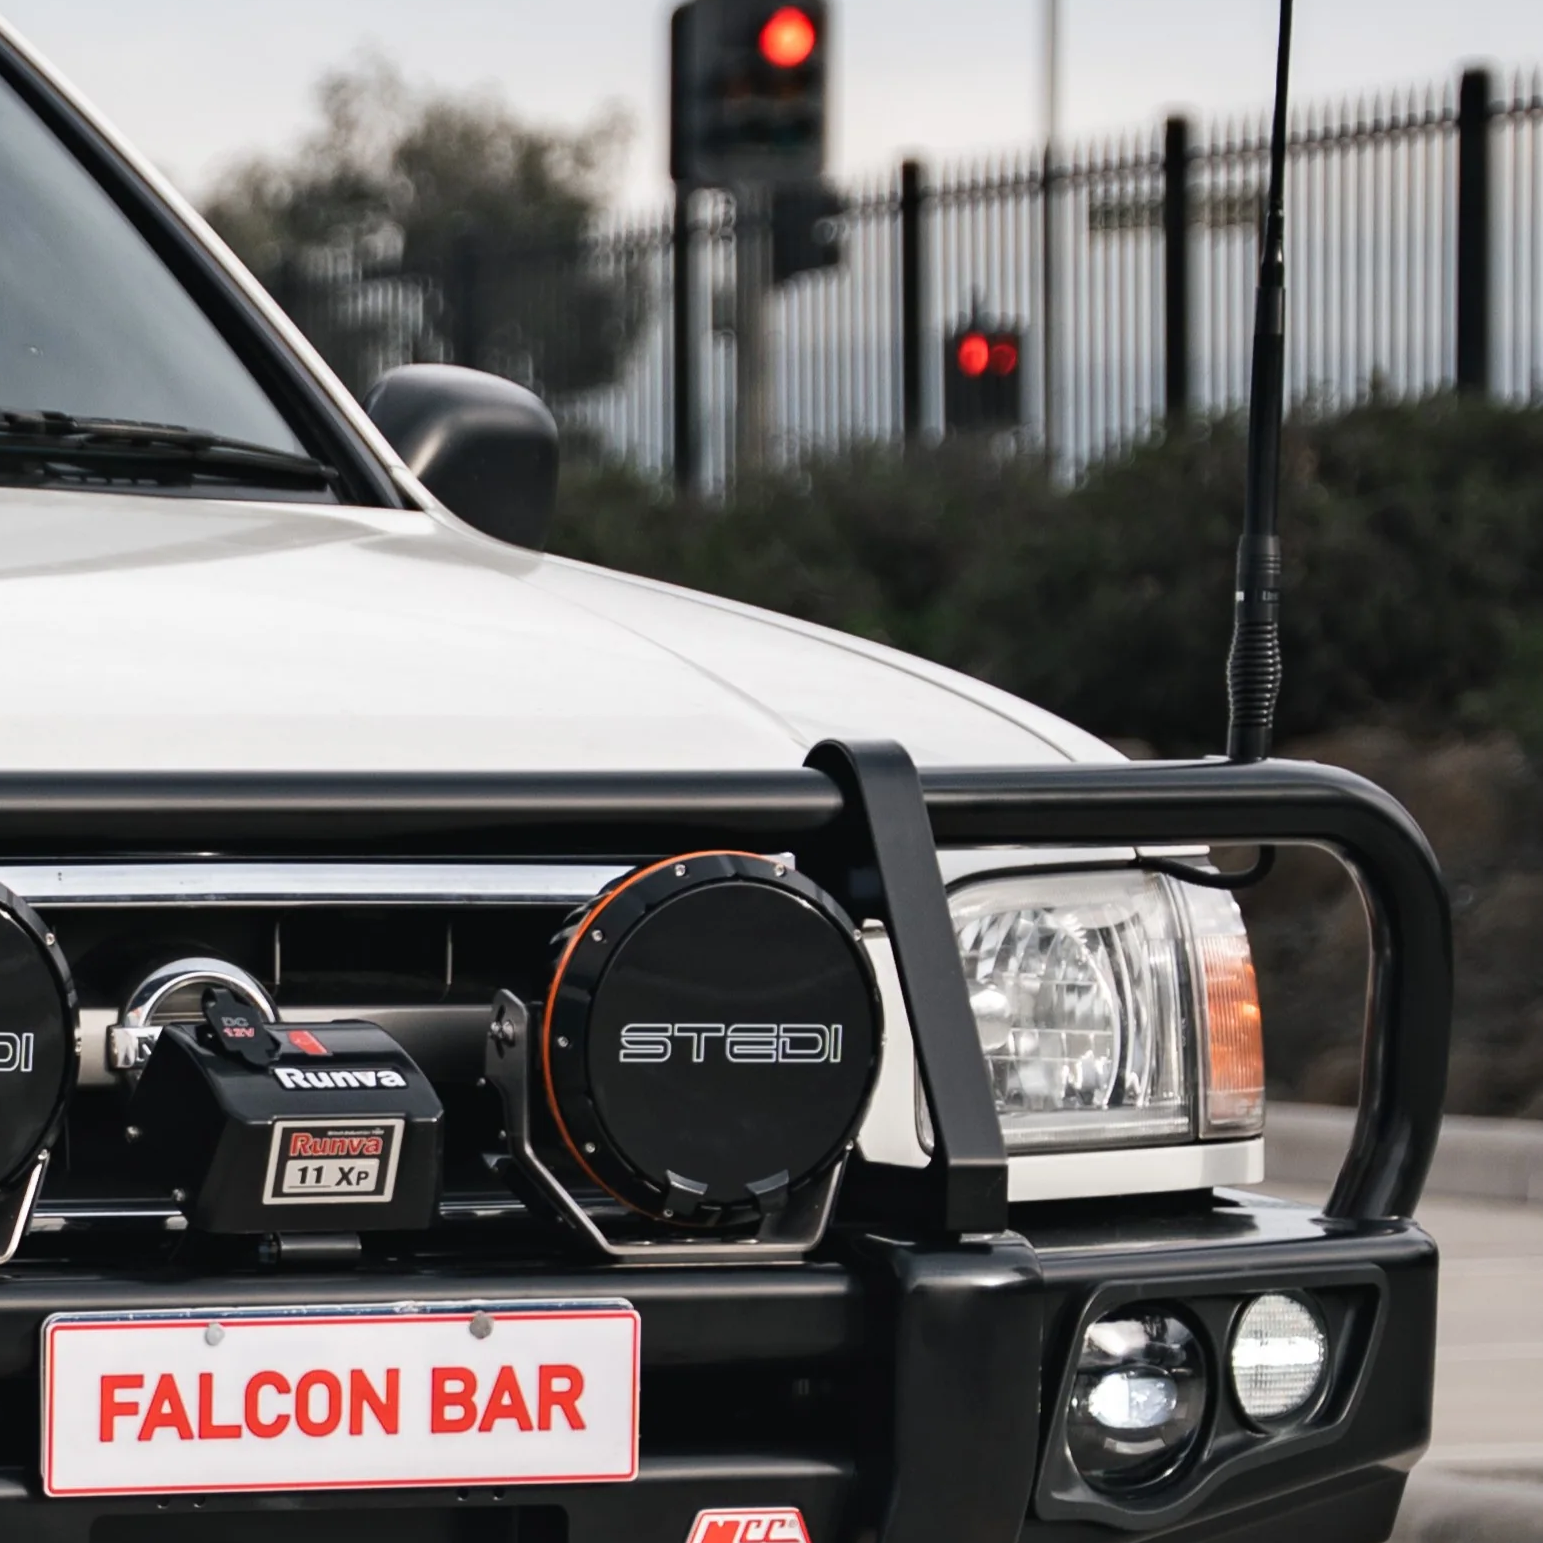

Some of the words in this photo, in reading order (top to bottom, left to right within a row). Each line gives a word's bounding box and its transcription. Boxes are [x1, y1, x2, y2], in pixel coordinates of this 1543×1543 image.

[221, 1017, 250, 1027] DC
[619, 1023, 843, 1063] STEDI
[274, 1067, 407, 1089] Runva
[289, 1132, 384, 1157] Runva
[297, 1165, 324, 1185] 11
[99, 1369, 401, 1443] FALCON
[430, 1364, 587, 1434] BAR
